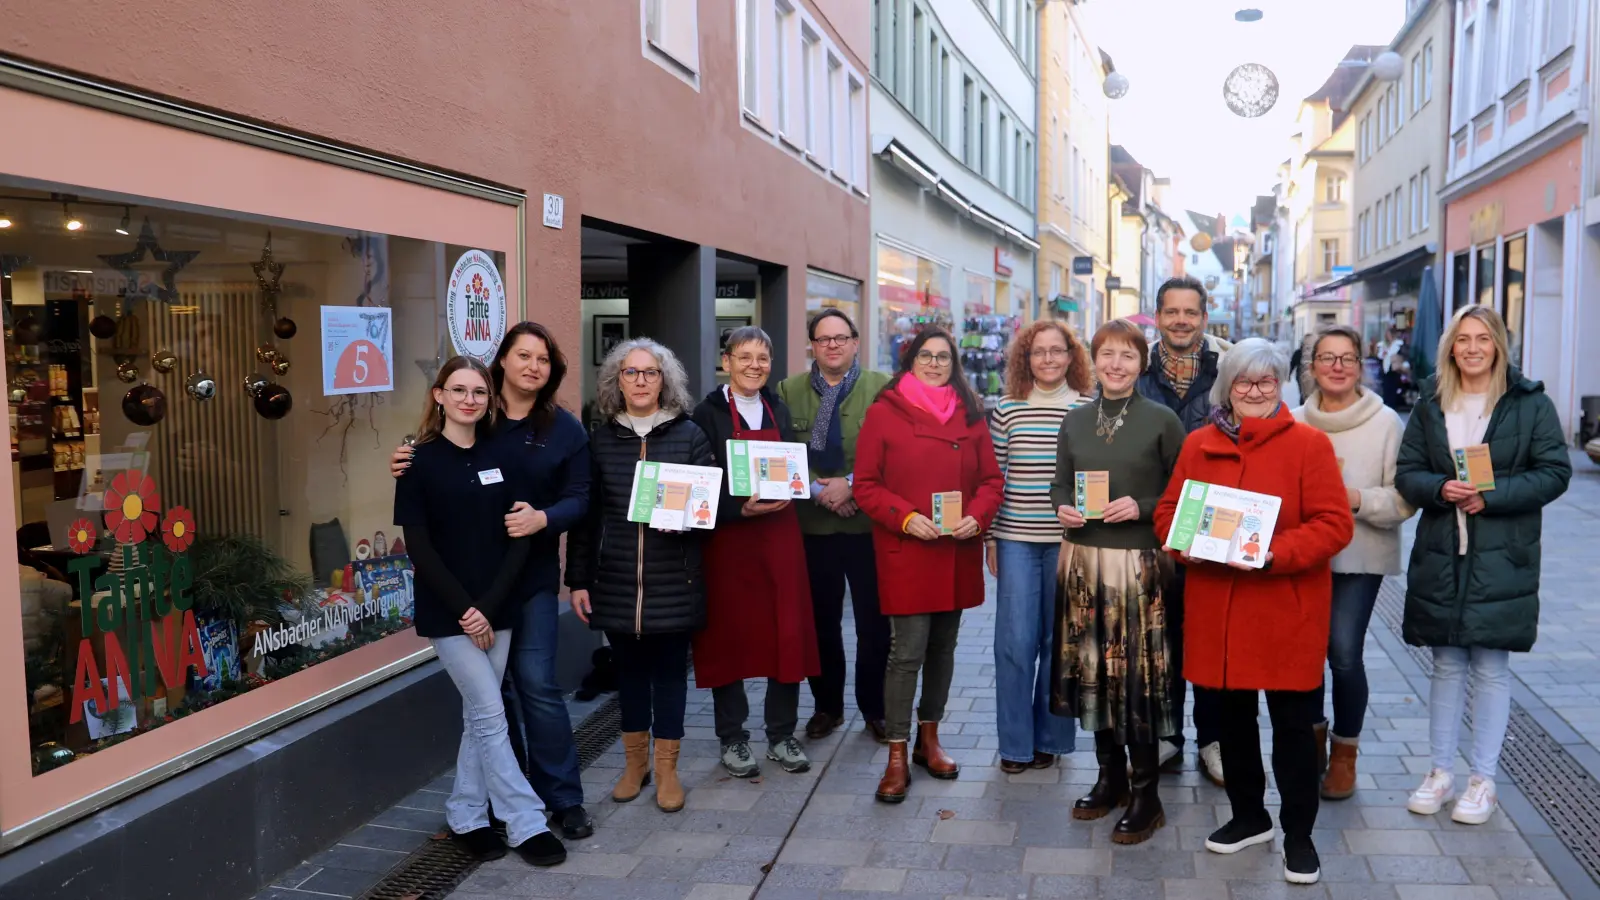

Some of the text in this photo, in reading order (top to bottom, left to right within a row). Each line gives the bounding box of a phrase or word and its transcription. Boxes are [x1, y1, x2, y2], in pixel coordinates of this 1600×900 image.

[547, 196, 560, 216] 30
[581, 282, 739, 298] da.vinc nst
[465, 295, 490, 319] Tante
[464, 318, 491, 341] ANNA
[353, 345, 369, 384] 5
[67, 543, 195, 638] Tante
[253, 588, 408, 659] ANsbacher NAhversorgung
[69, 609, 208, 725] ANNA
